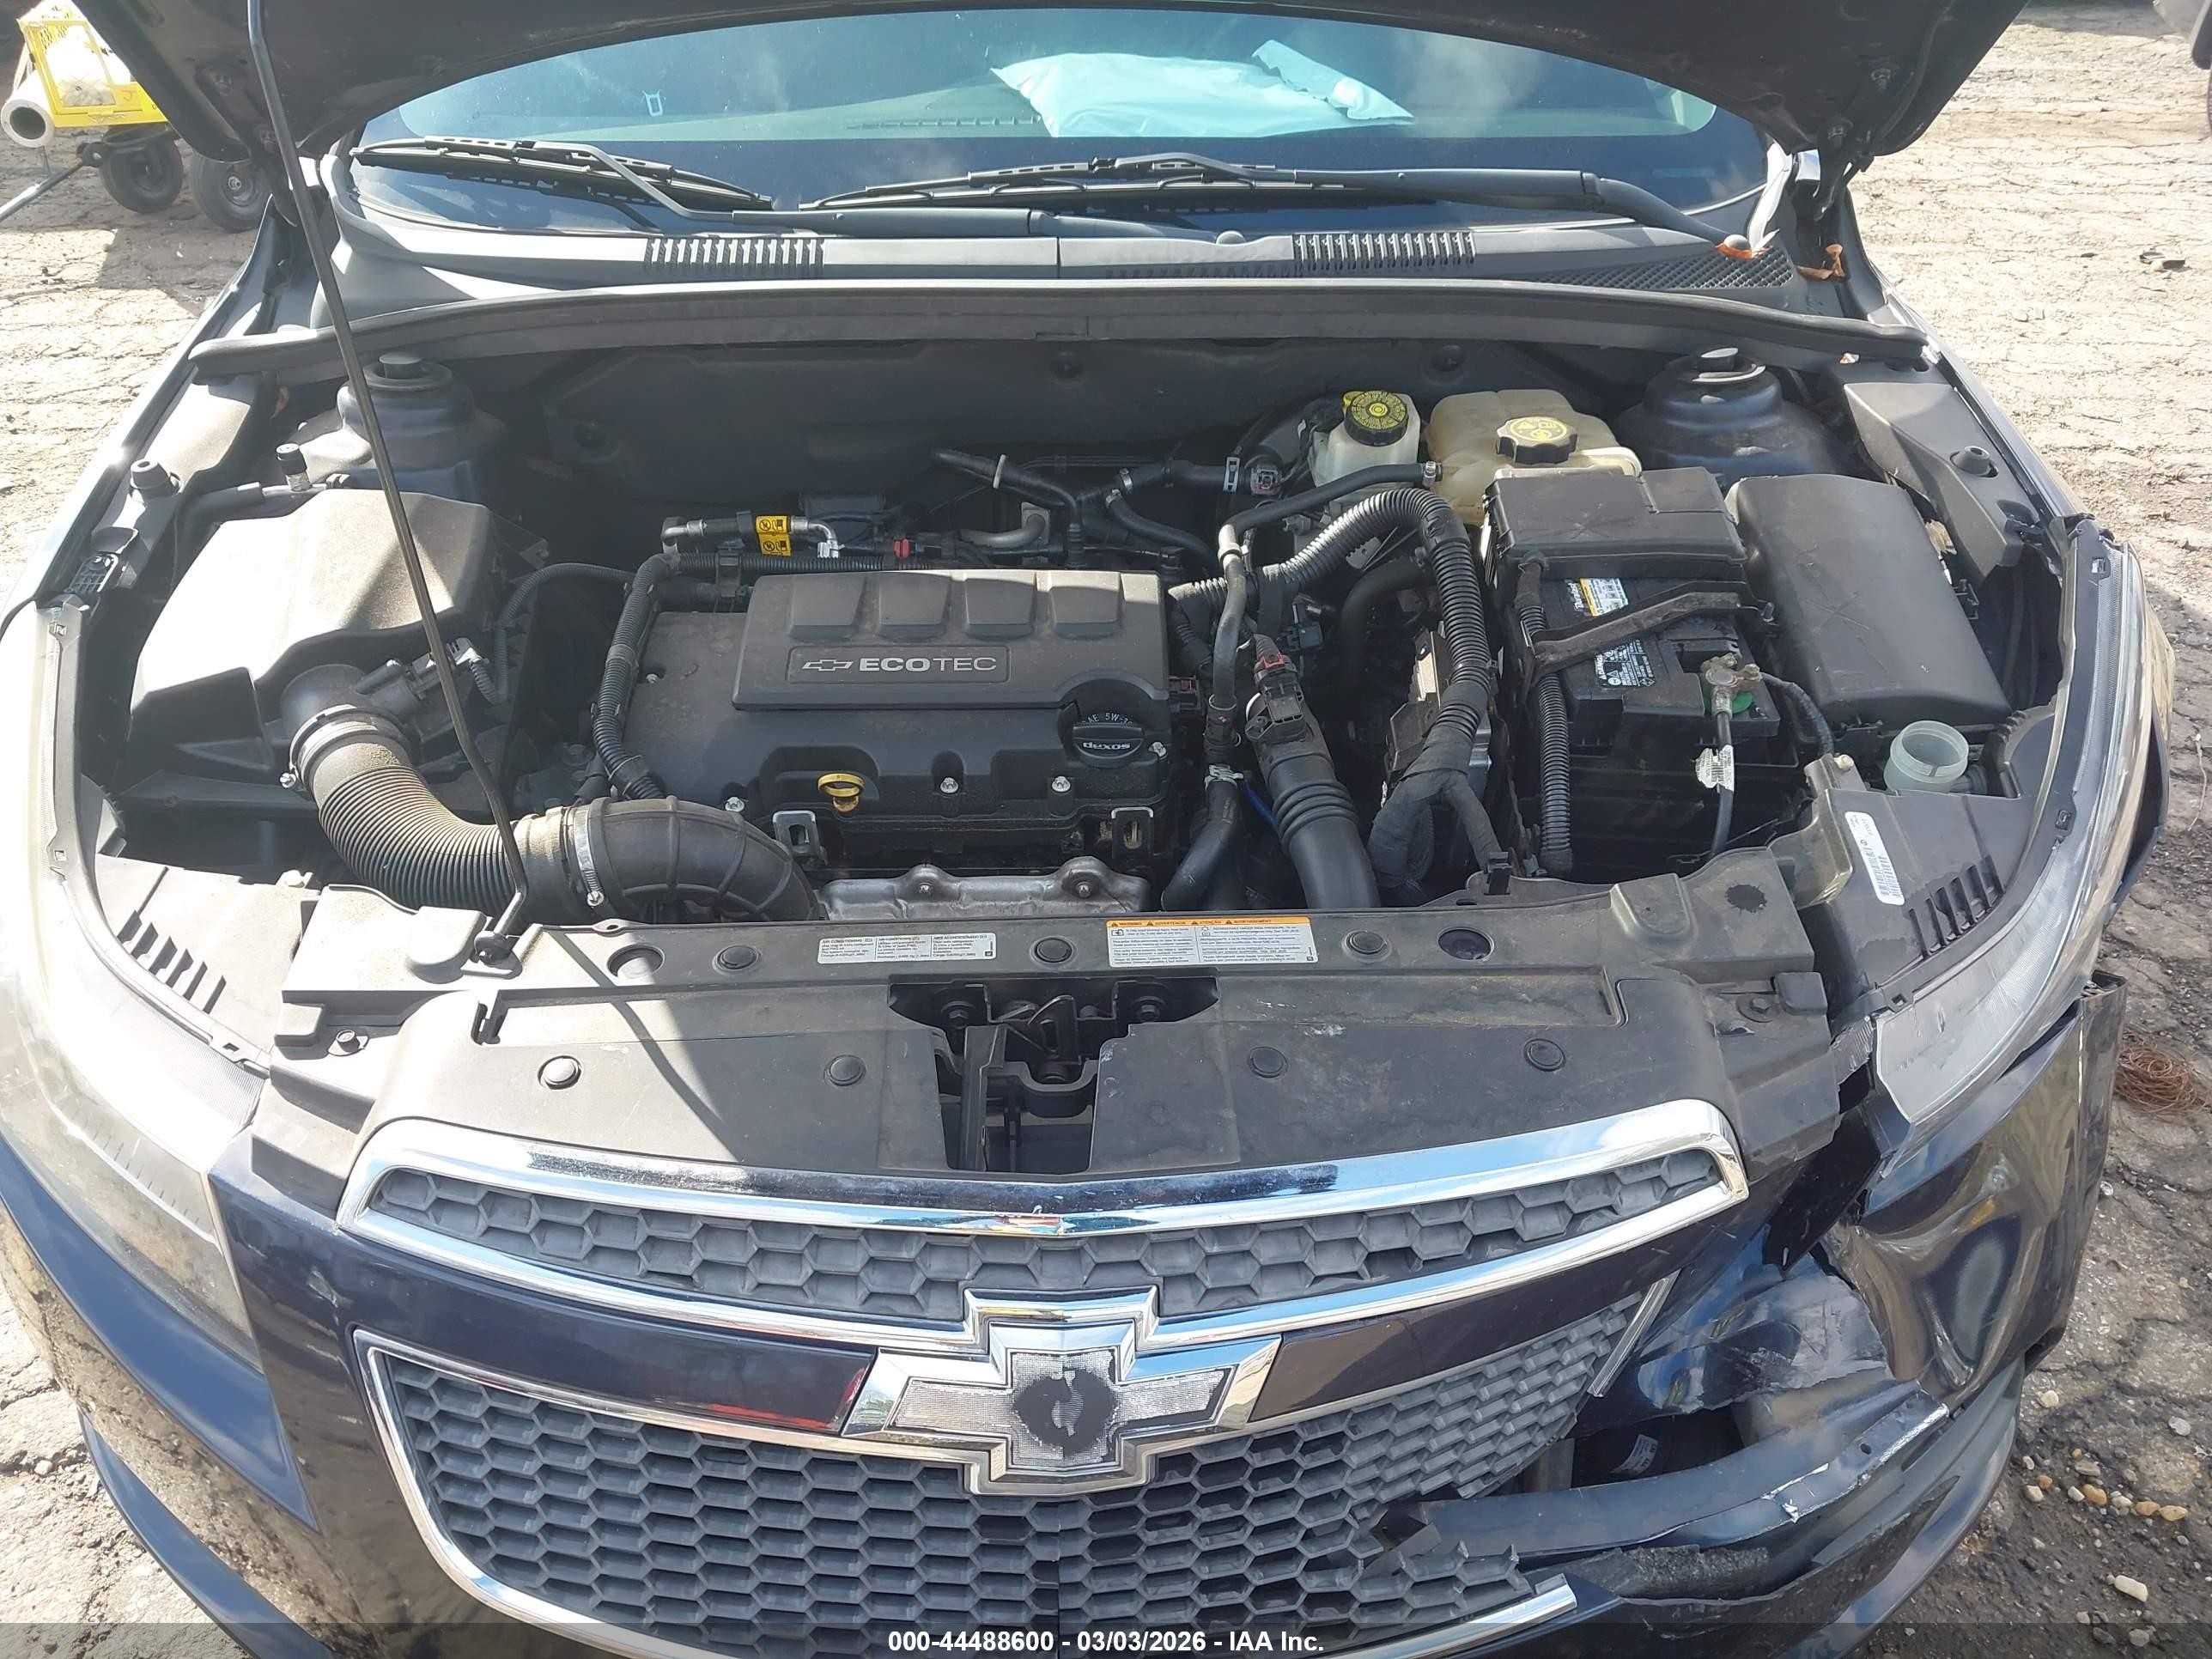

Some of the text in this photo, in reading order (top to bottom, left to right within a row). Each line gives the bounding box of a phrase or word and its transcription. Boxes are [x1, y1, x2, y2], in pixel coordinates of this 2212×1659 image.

[859, 657, 997, 672] ECOTEC
[1081, 714, 1100, 724] AE
[1083, 741, 1131, 750] dexos
